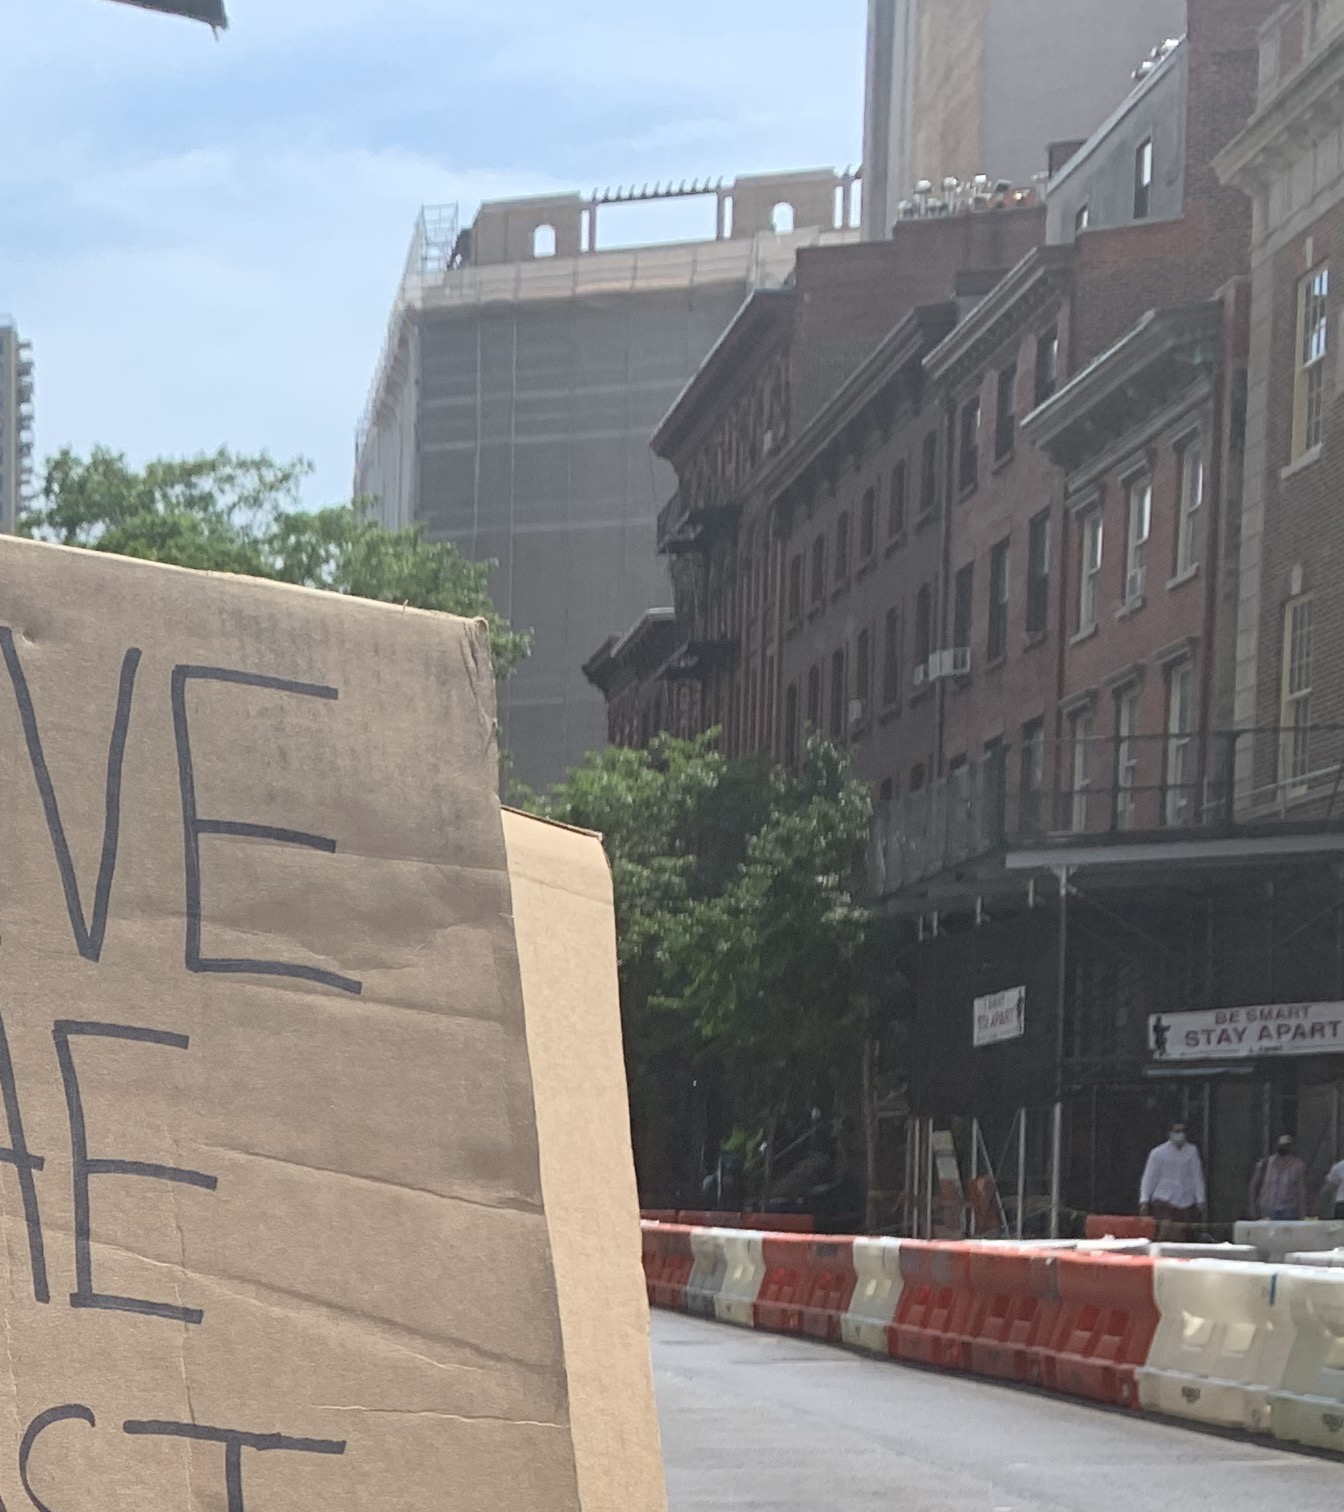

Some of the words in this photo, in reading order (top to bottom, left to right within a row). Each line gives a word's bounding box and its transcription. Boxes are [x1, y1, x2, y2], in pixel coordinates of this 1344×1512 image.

[1214, 1011, 1241, 1025] BE
[1246, 1005, 1311, 1023] SMART
[1185, 1026, 1247, 1048] STAY
[1258, 1020, 1342, 1042] APART
